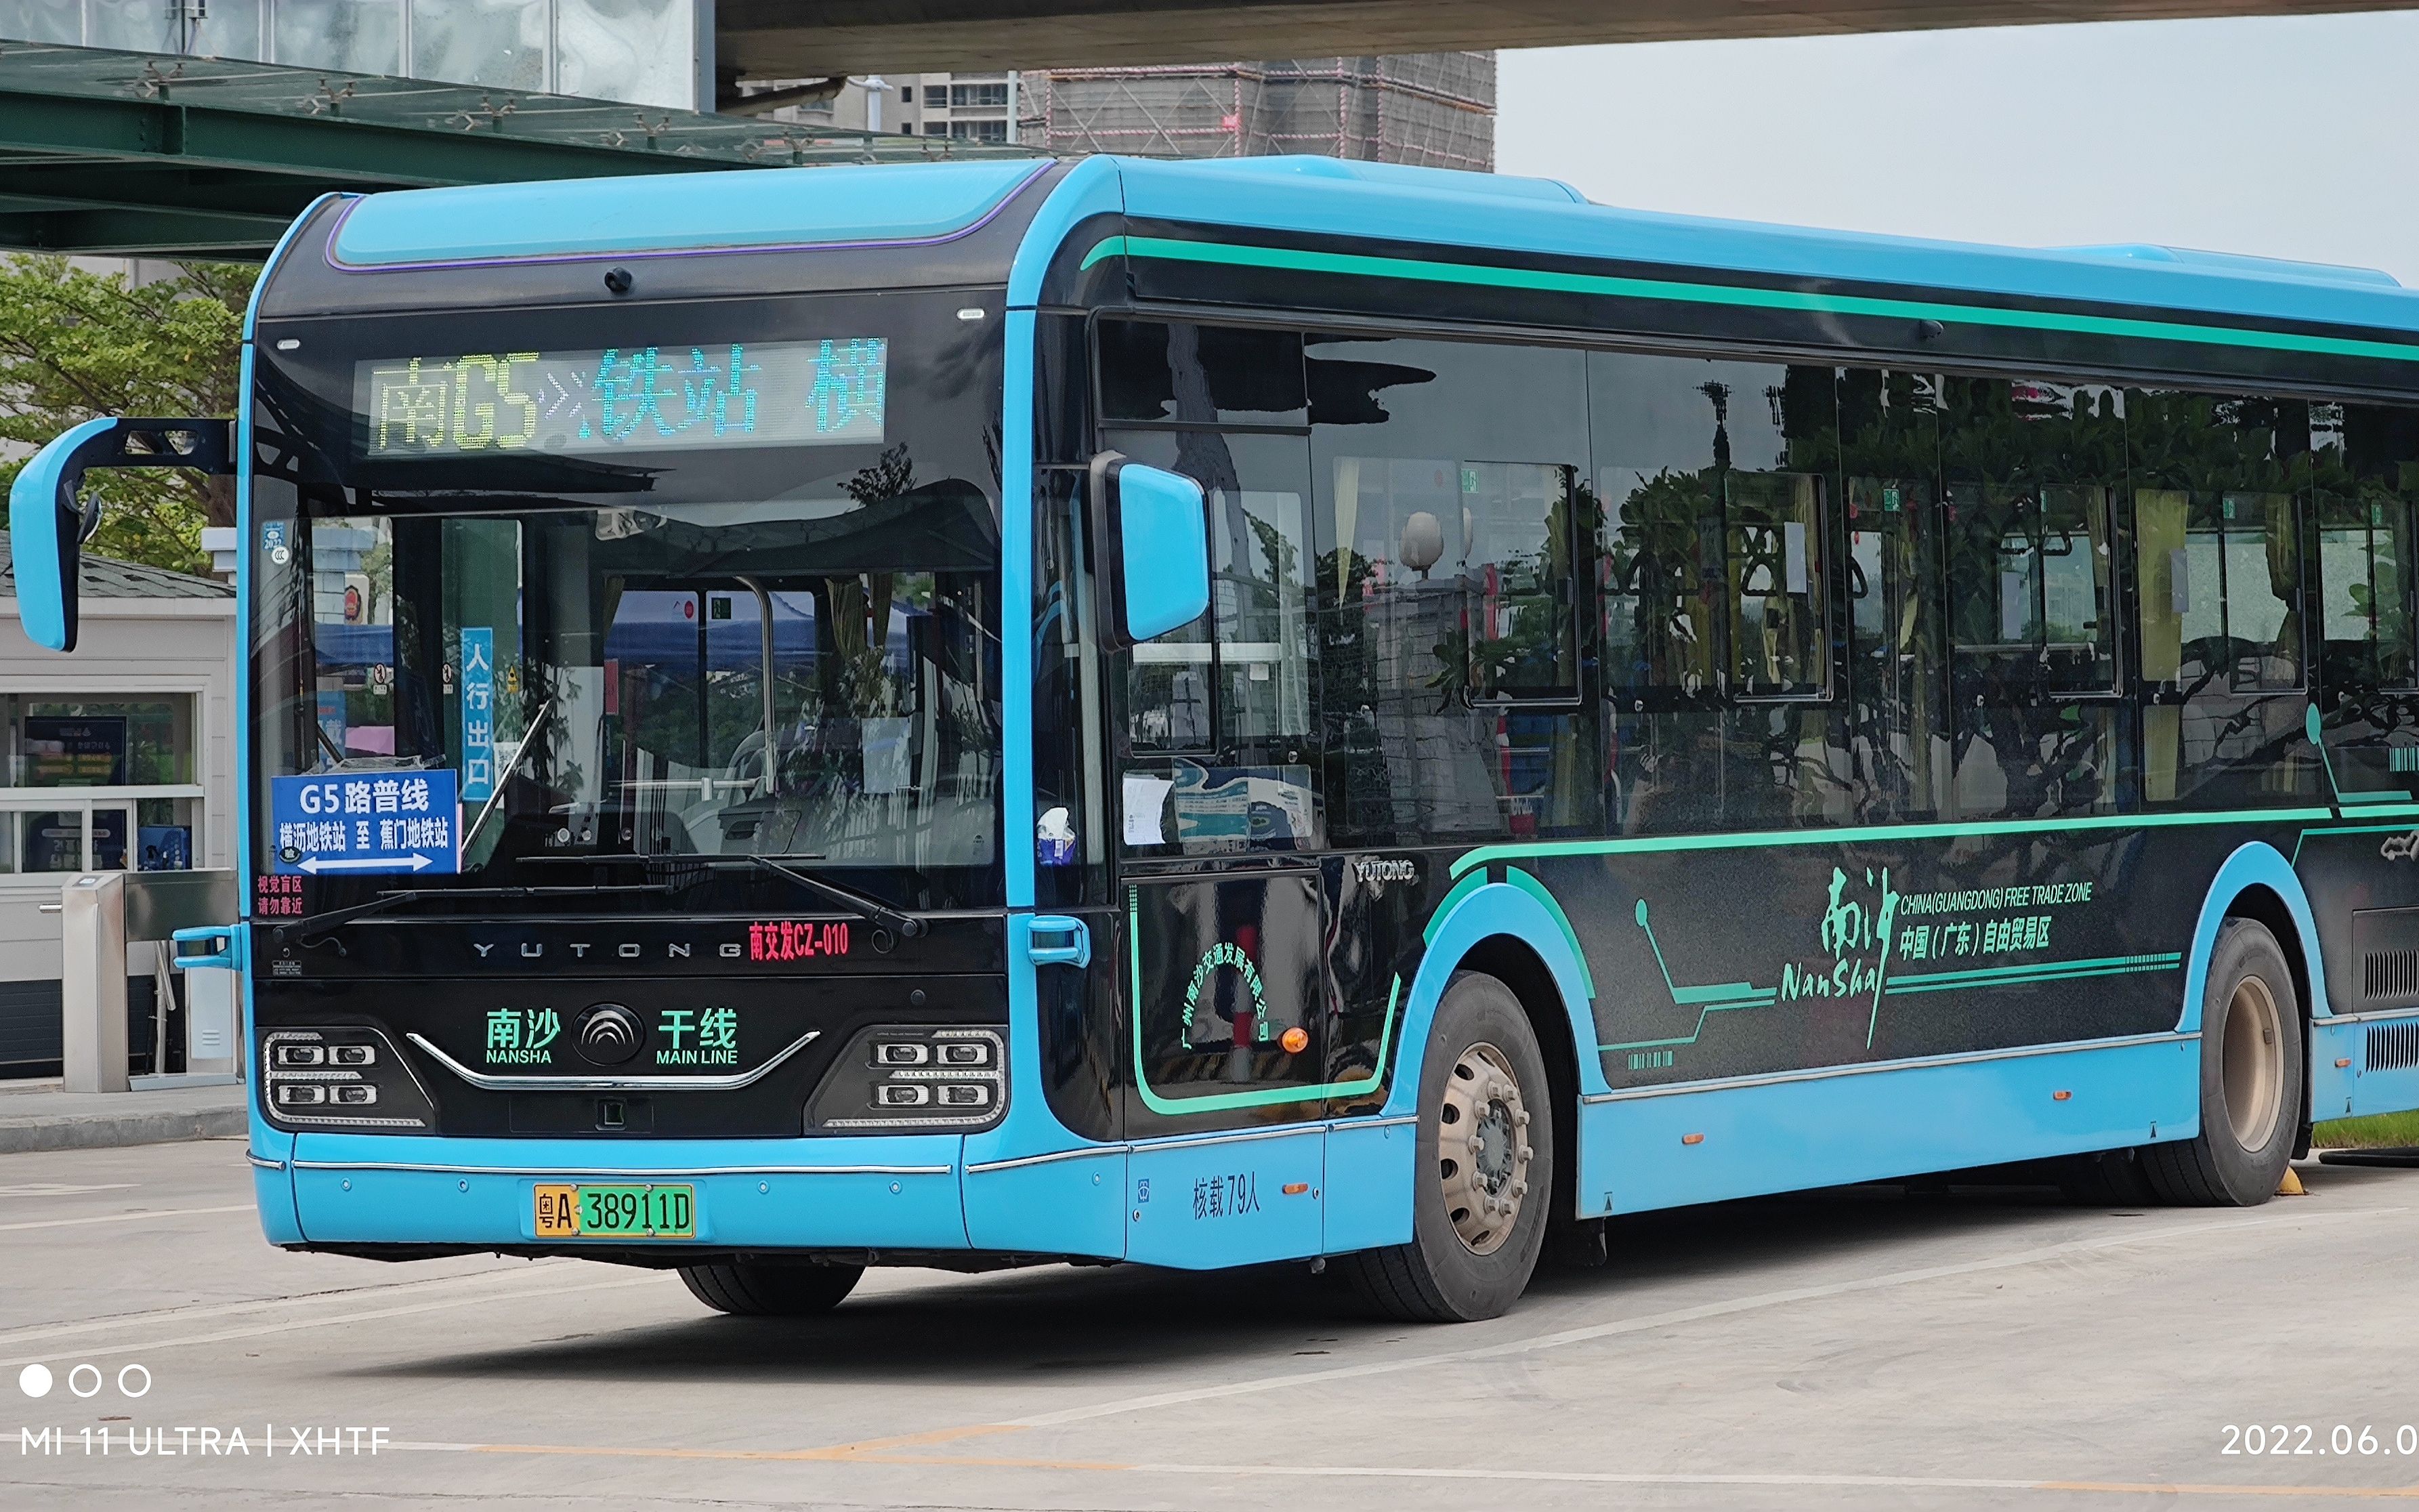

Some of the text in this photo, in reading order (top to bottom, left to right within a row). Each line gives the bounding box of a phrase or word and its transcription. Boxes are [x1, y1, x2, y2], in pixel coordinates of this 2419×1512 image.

[373, 350, 539, 453] 南G5
[591, 341, 763, 443] 铁站
[264, 539, 282, 549] 2022
[465, 643, 490, 785] 人行出口
[299, 778, 429, 815] G5路普线
[279, 816, 449, 854] 横沥地铁站 至 蕉门地铁站
[257, 875, 303, 894] 视觉盲区
[1352, 859, 1415, 883] YUTONG
[257, 896, 303, 915] 请勿靠近
[2004, 885, 2031, 908] FREE
[2031, 883, 2065, 906] TRADE
[2064, 881, 2093, 903] ZONE
[473, 943, 743, 958] YUTONG
[749, 920, 849, 962] 南交发CZ-010
[1181, 942, 1269, 1050] 广州南沙交通发展有限公司
[486, 1007, 562, 1049] 南沙
[657, 1007, 738, 1050] 干线
[485, 1049, 553, 1064] NANSHA
[656, 1049, 738, 1065] MAIN LINE
[1192, 1171, 1261, 1221] 核载79人
